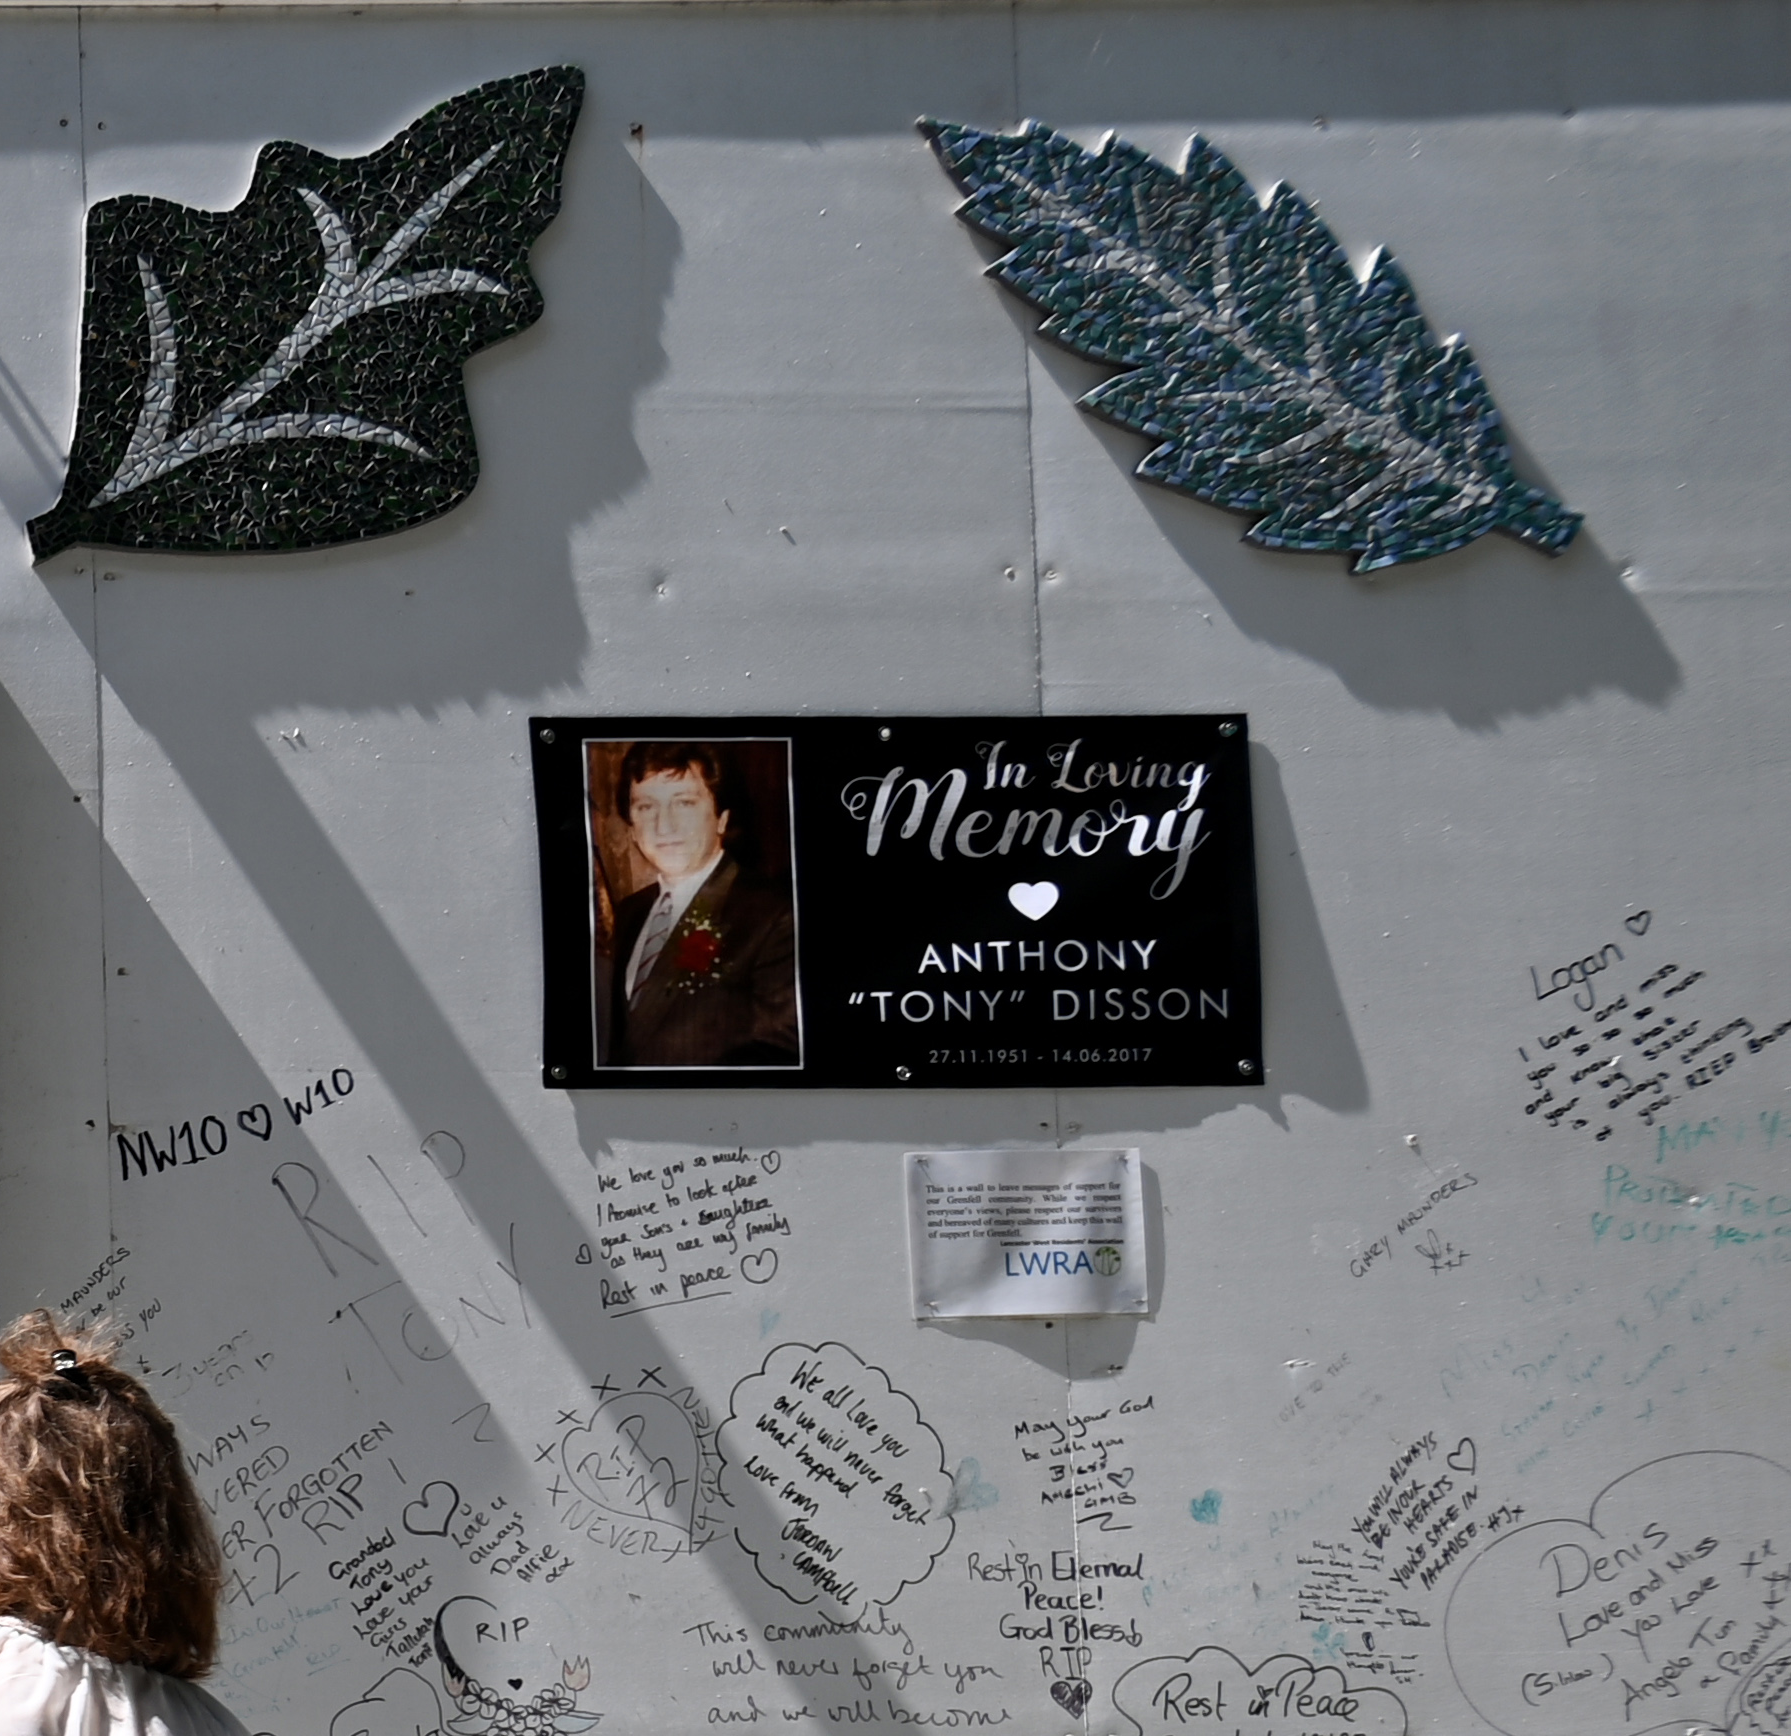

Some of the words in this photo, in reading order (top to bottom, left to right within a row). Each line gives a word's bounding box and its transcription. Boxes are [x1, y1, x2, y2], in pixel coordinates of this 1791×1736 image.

[975, 740, 1036, 790] In
[1047, 738, 1212, 811] Loving
[841, 766, 1211, 900] Memory
[917, 939, 1158, 974] ANTHONY
[1530, 943, 1625, 1012] Logan
[848, 989, 1025, 1023] "TONY"
[1052, 987, 1229, 1022] DISSON
[929, 1049, 1029, 1064] 27.11.1951
[1052, 1048, 1153, 1063] 14.06.2017
[116, 1114, 228, 1182] NW10
[282, 1067, 356, 1127] W10
[926, 1184, 944, 1193] This
[966, 1183, 983, 1191] wall
[998, 1183, 1019, 1191] leave
[1075, 1183, 1106, 1192] support
[1109, 1182, 1120, 1190] for
[947, 1195, 981, 1204] Grenfell
[927, 1207, 972, 1217] everyone's
[1006, 1206, 1030, 1216] please
[1034, 1207, 1063, 1215] respect
[928, 1219, 942, 1227] and
[1017, 1218, 1049, 1226] cultures
[1068, 1217, 1088, 1226] keep
[1106, 1216, 1122, 1224] wall
[939, 1231, 970, 1239] support
[973, 1229, 984, 1237] for
[987, 1229, 1022, 1237] Grenfell.
[1005, 1250, 1094, 1276] LWRA
[1152, 1672, 1227, 1723] Rest
[1248, 1684, 1275, 1718] in
[1275, 1667, 1360, 1723] Peace
